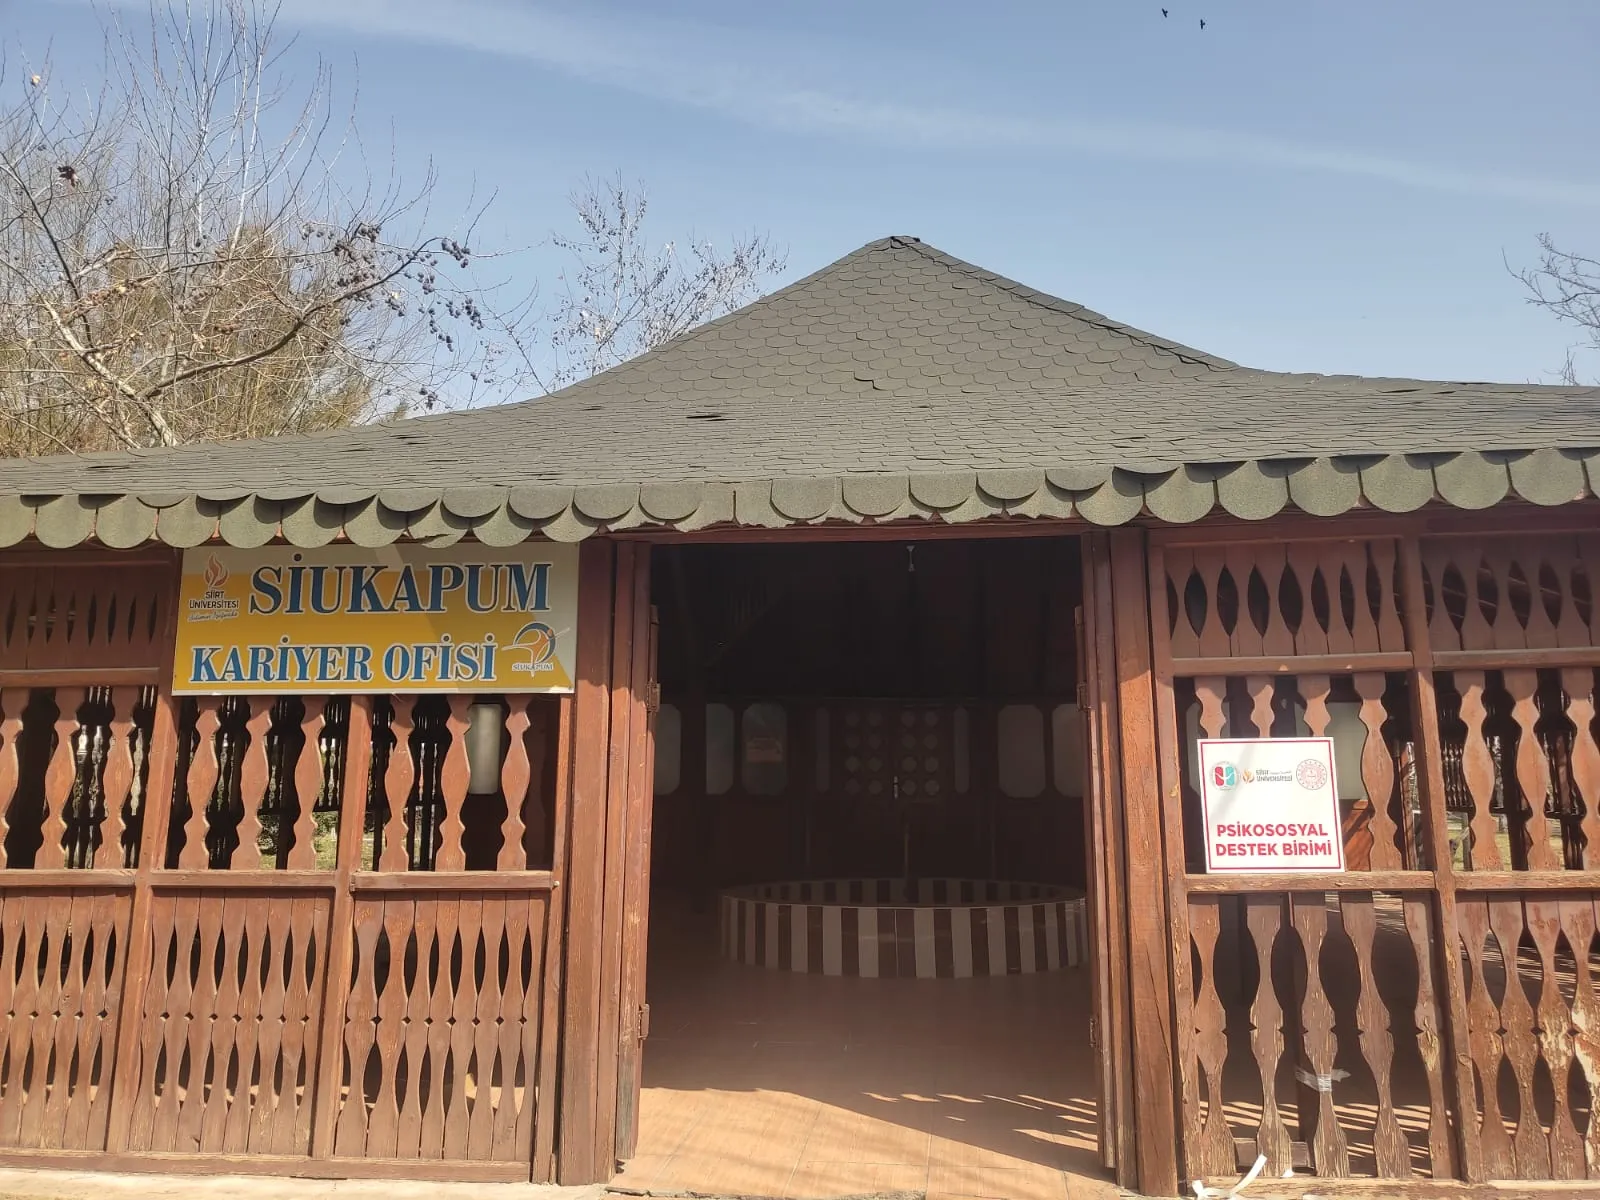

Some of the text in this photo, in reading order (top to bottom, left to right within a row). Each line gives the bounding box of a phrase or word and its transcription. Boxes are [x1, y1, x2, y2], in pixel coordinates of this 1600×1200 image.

[249, 553, 552, 614] SİUKAPUM
[189, 633, 497, 683] KARİYER OFİSİ
[1217, 821, 1328, 837] PSİKOSOSYAL
[1216, 840, 1332, 857] DESTEK BİRİMİ
